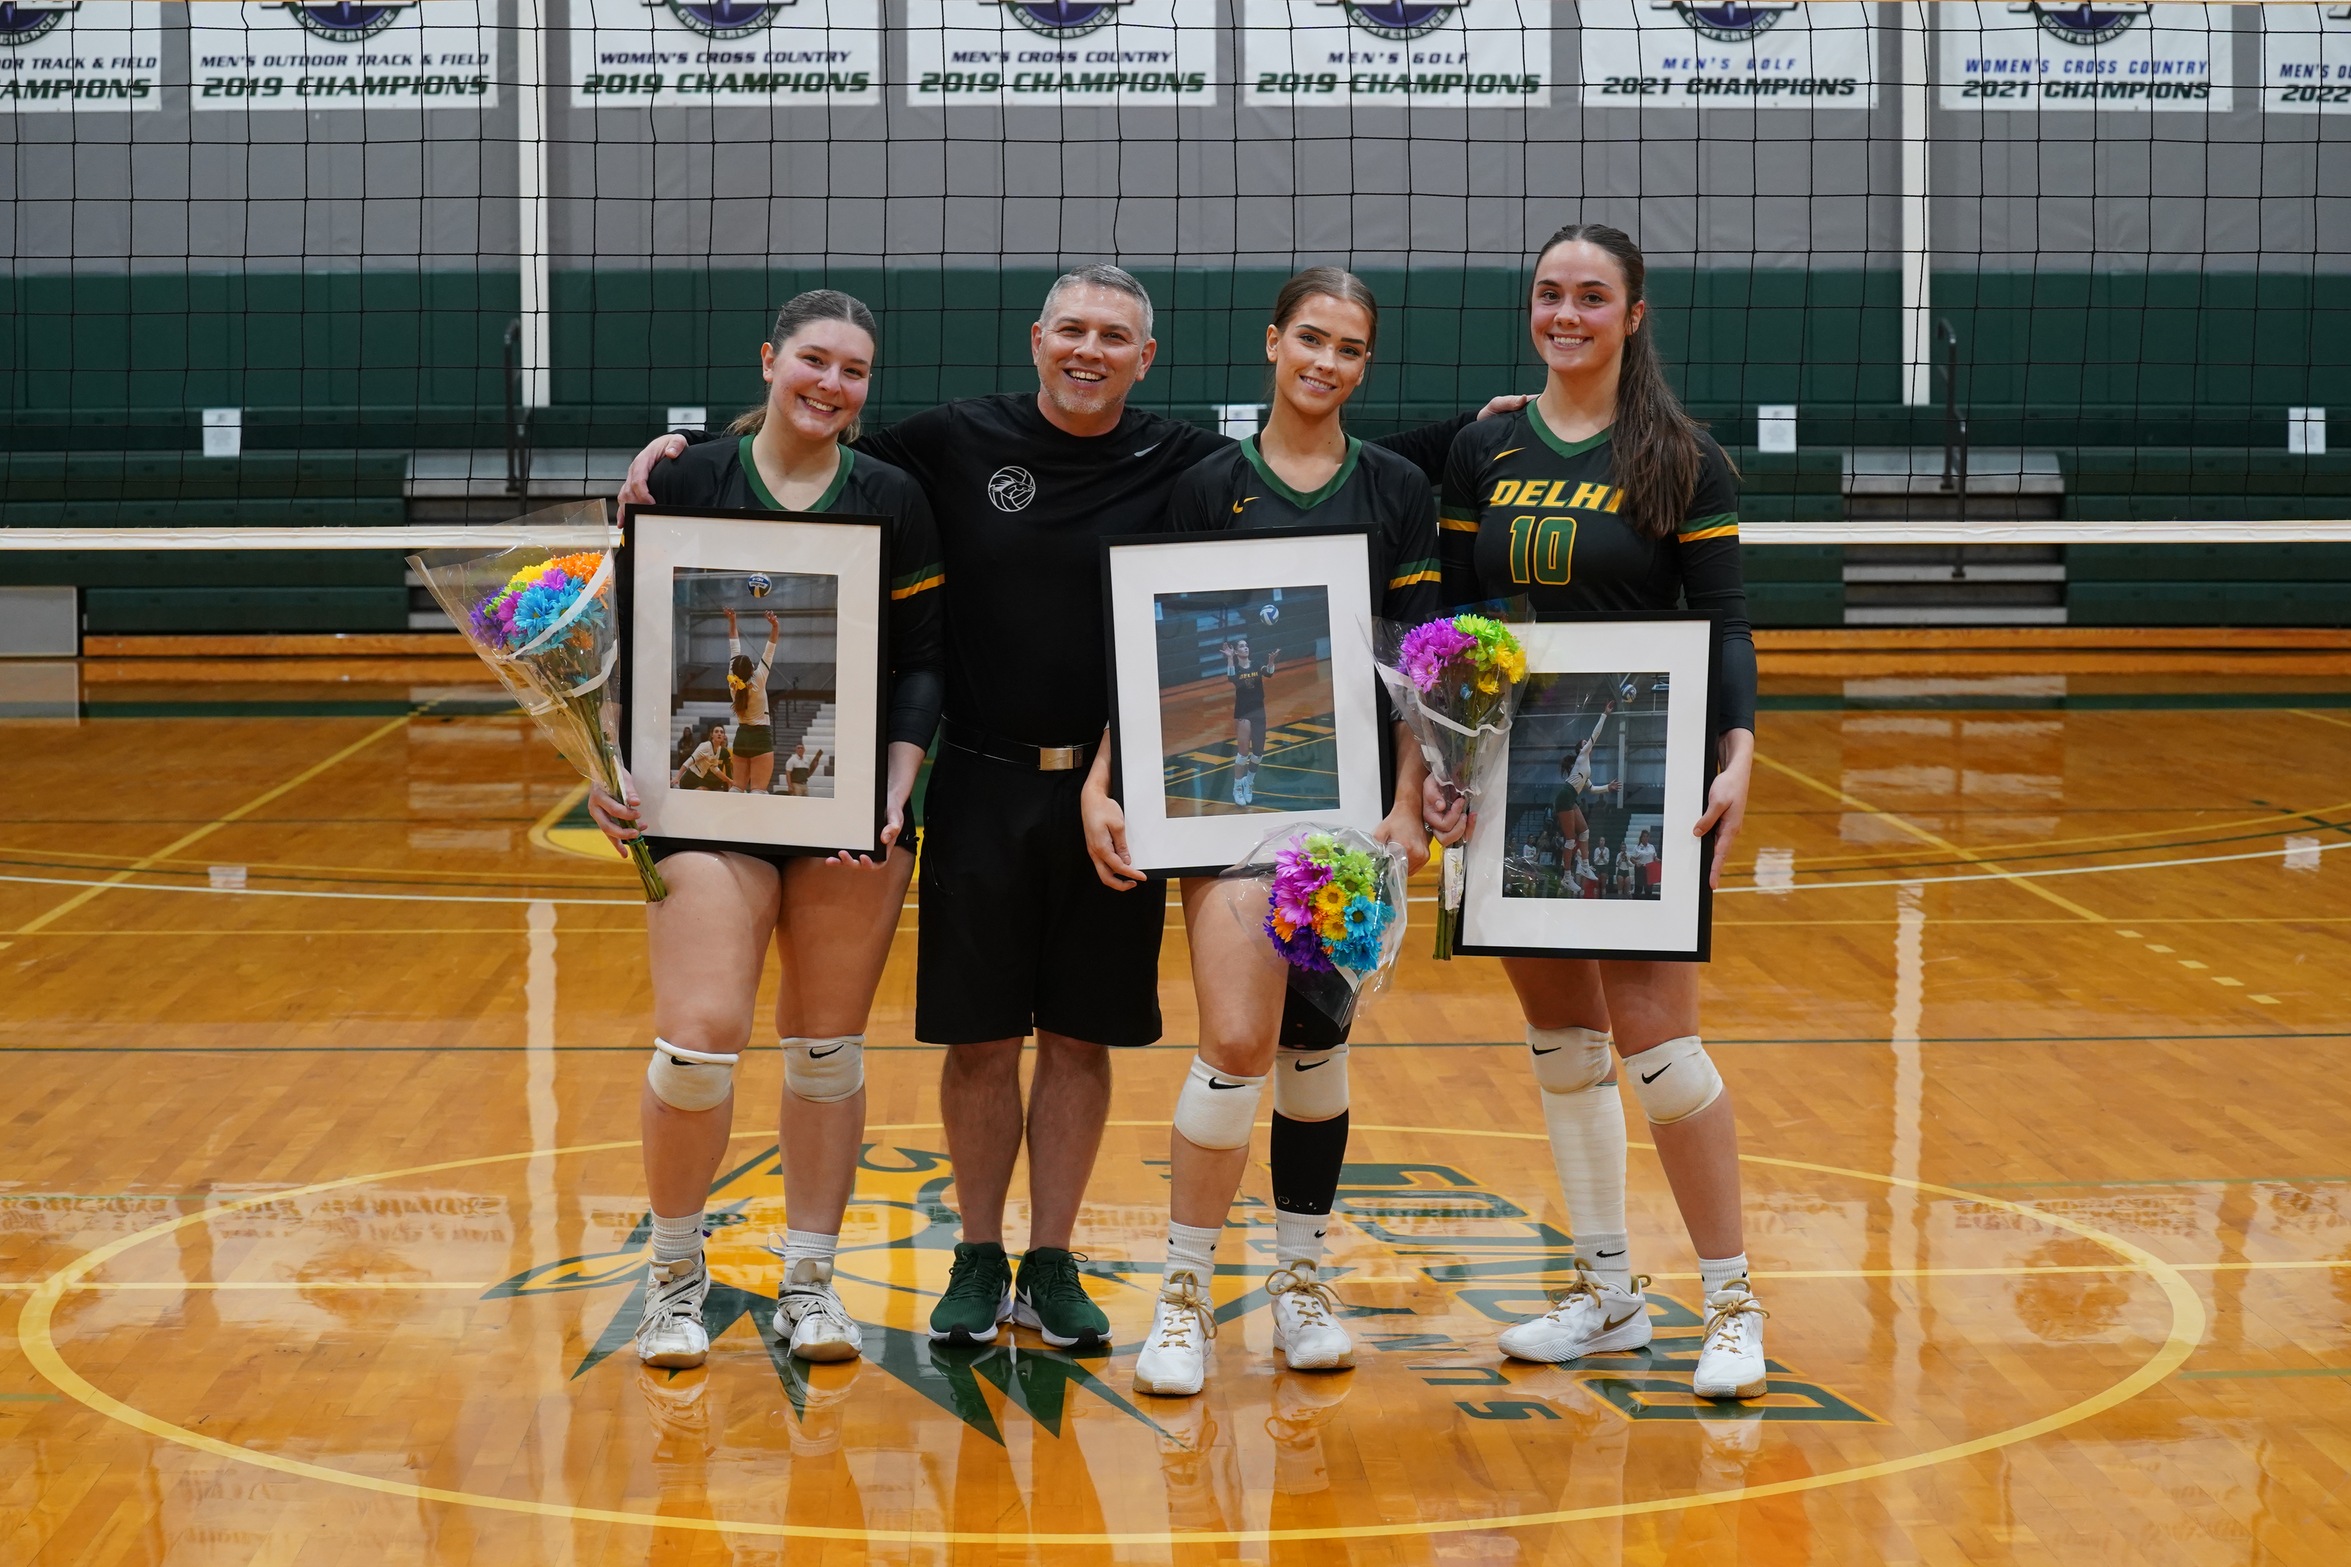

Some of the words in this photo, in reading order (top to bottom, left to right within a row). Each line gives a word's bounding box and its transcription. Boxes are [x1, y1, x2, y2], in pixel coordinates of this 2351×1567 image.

[0, 13, 58, 45] ERENCE
[0, 57, 25, 70] OR
[32, 57, 86, 70] TRACK
[91, 57, 105, 70] &
[111, 56, 157, 69] FIELD
[200, 54, 255, 68] MEN'S
[263, 54, 348, 68] OUTDOOR
[357, 53, 414, 67] TRACK
[420, 54, 433, 67] &
[439, 53, 490, 67] FIELD
[600, 51, 689, 65] WOMEN'S
[696, 51, 757, 64] CROSS
[764, 50, 852, 64] COUNTRY
[950, 51, 1010, 64] MEN'S
[1017, 51, 1078, 64] CROSS
[1085, 50, 1173, 64] COUNTRY
[1327, 51, 1400, 65] MEN'S
[1412, 51, 1471, 65] GOLF
[1661, 57, 1732, 71] MEN'S
[1746, 58, 1798, 71] GOLF
[1964, 57, 2050, 74] WOMEN'S
[2063, 59, 2119, 75] CROSS
[2128, 59, 2209, 76] COUNTRY
[2279, 63, 2330, 79] MEN'S
[0, 77, 152, 100] AMPIONS
[201, 76, 284, 98] 2019
[295, 74, 490, 97] CHAMPIONS
[582, 73, 664, 95] 2019
[675, 71, 871, 94] CHAMPIONS
[918, 72, 1002, 94] 2019
[1012, 71, 1206, 94] CHAMPIONS
[1255, 73, 1338, 94] 2019
[1349, 73, 1541, 95] CHAMPIONS
[1601, 76, 1672, 96] 2021
[1685, 76, 1857, 97] CHAMPIONS
[1961, 79, 2031, 99] 2021
[2044, 80, 2211, 101] CHAMPIONS
[2280, 83, 2351, 104] 2022
[1489, 478, 1625, 515] DELHI
[1508, 515, 1577, 586] 10
